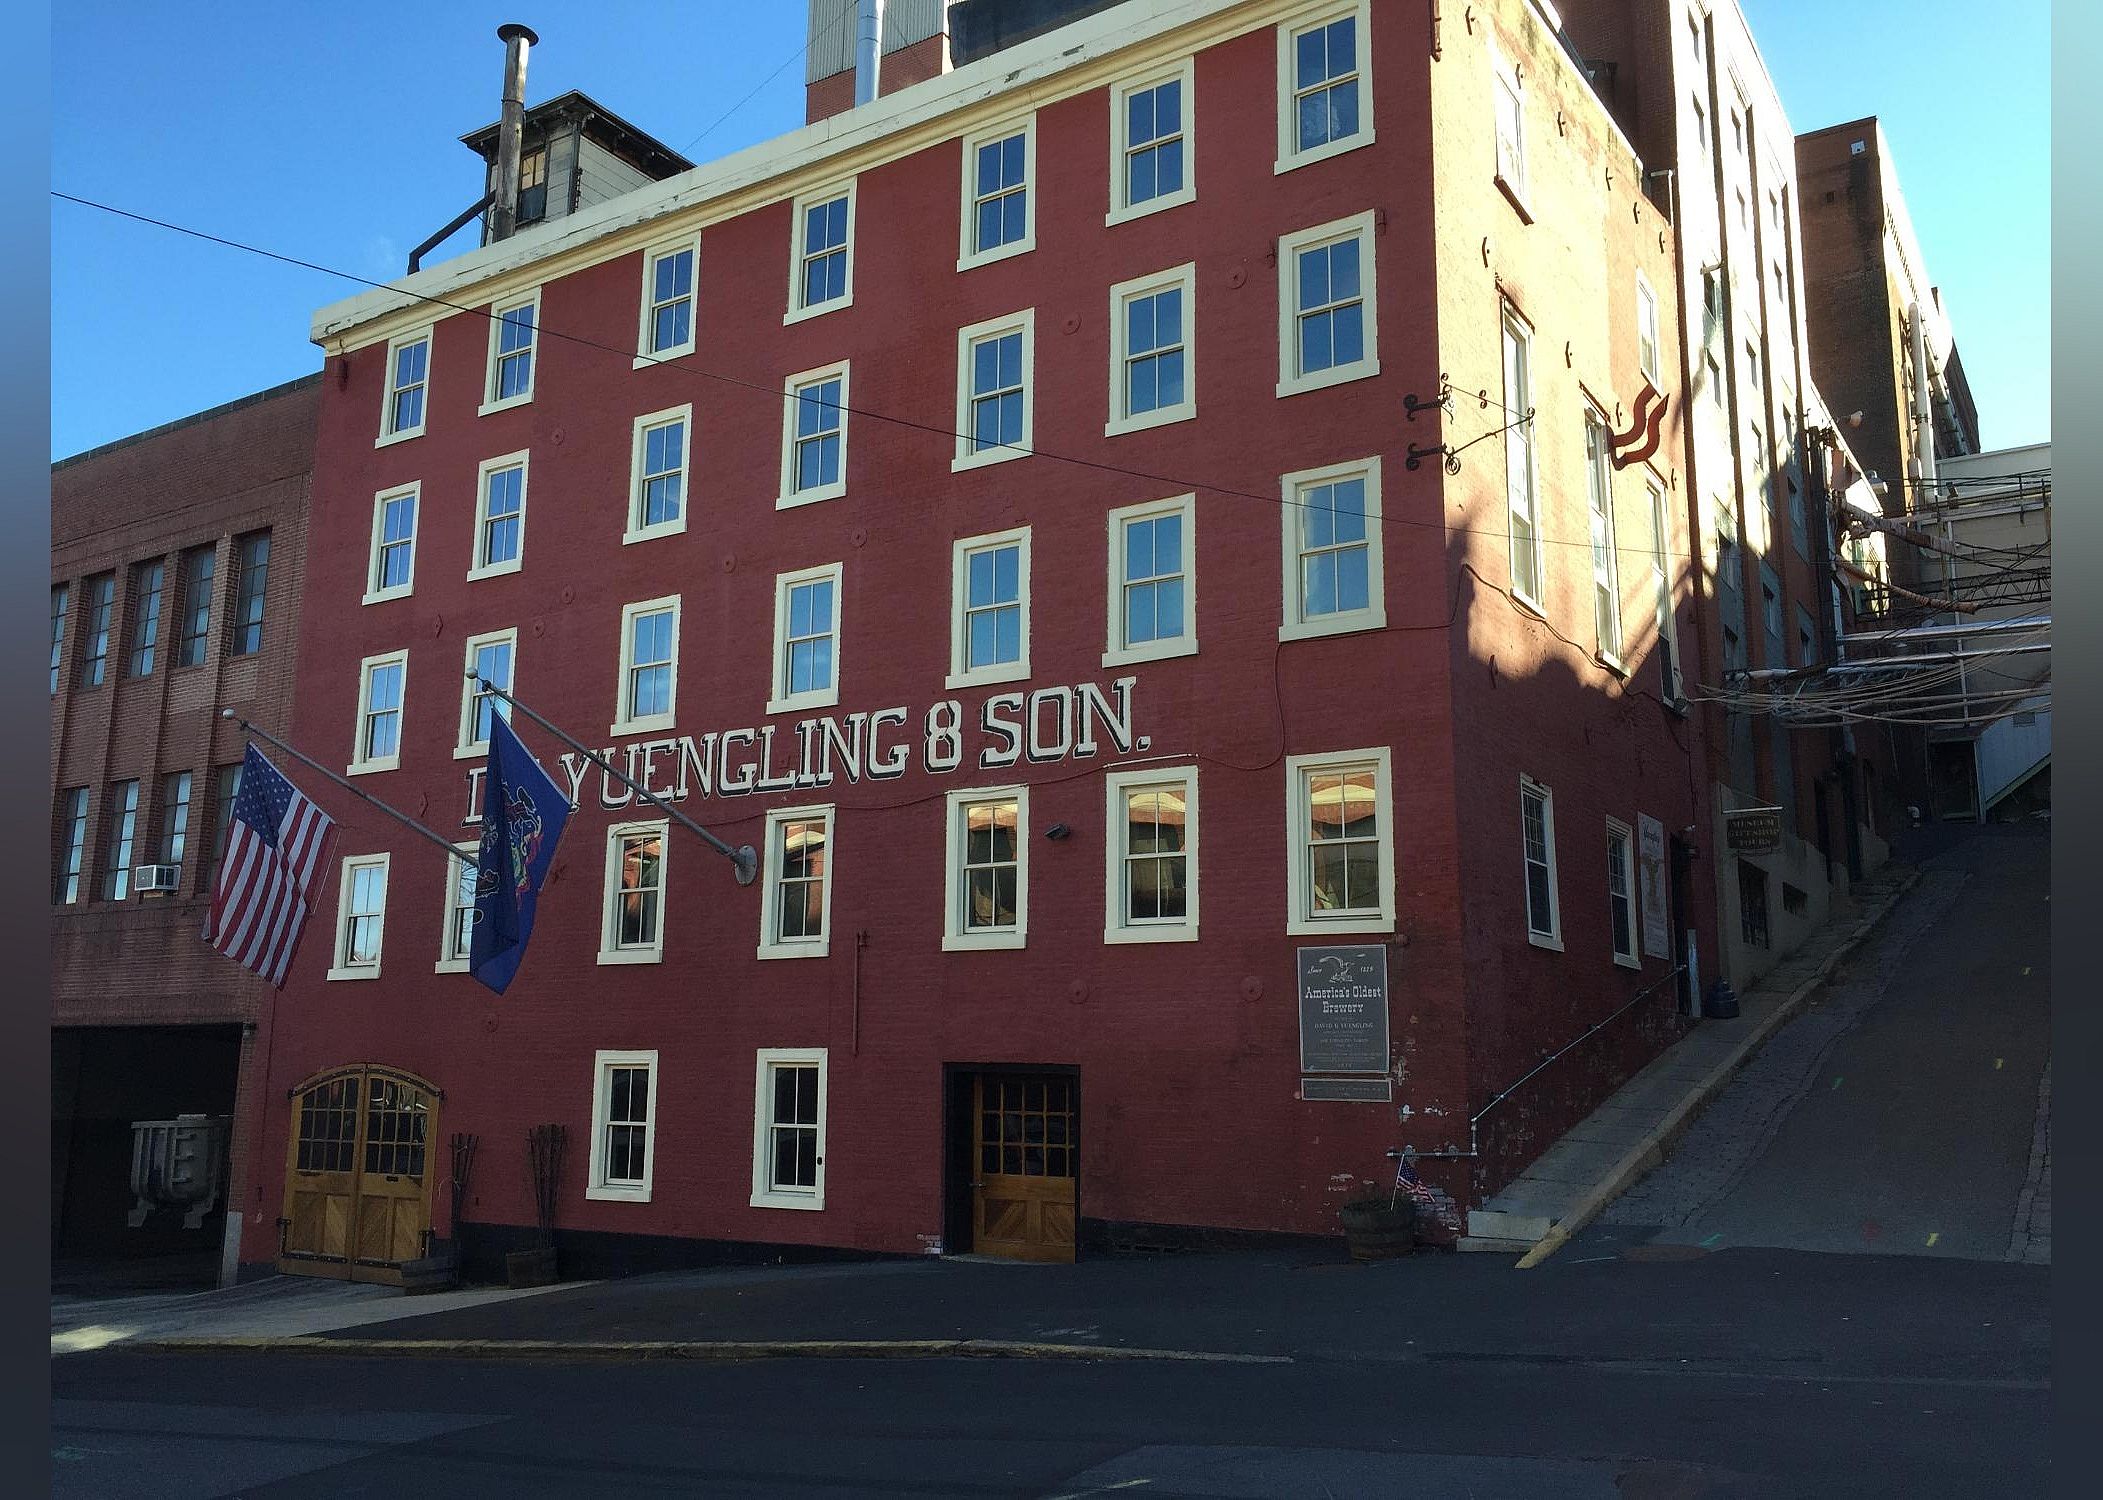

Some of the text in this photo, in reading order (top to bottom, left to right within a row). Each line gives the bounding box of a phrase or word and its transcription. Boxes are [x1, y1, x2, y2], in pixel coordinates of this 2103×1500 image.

[558, 706, 911, 813] YUENGLING
[978, 676, 1151, 770] SON.
[1305, 984, 1382, 999] America's Oldest
[1322, 1000, 1364, 1014] Brewery
